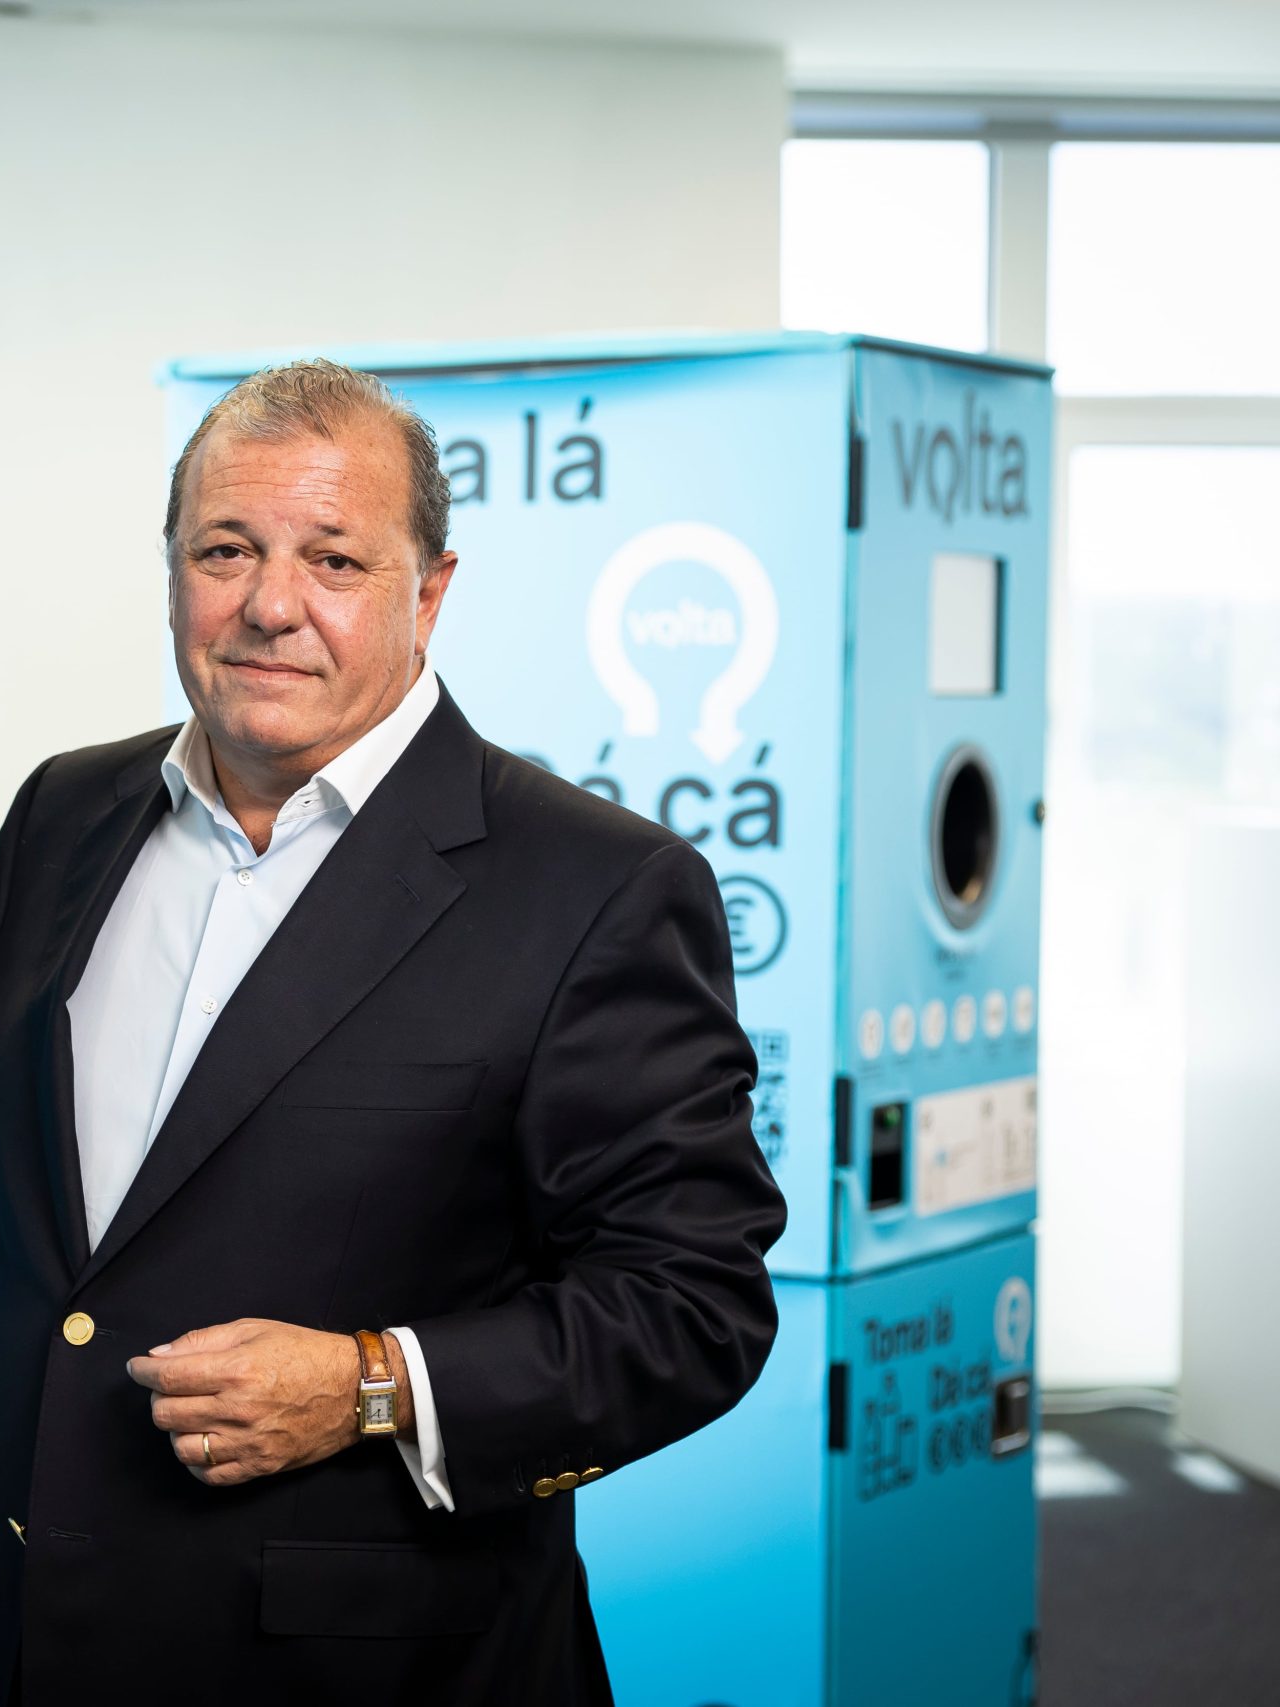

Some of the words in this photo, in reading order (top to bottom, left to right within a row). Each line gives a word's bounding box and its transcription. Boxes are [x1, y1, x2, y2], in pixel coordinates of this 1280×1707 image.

[524, 397, 604, 503] lá
[890, 386, 1030, 524] volta
[660, 742, 780, 848] cá
